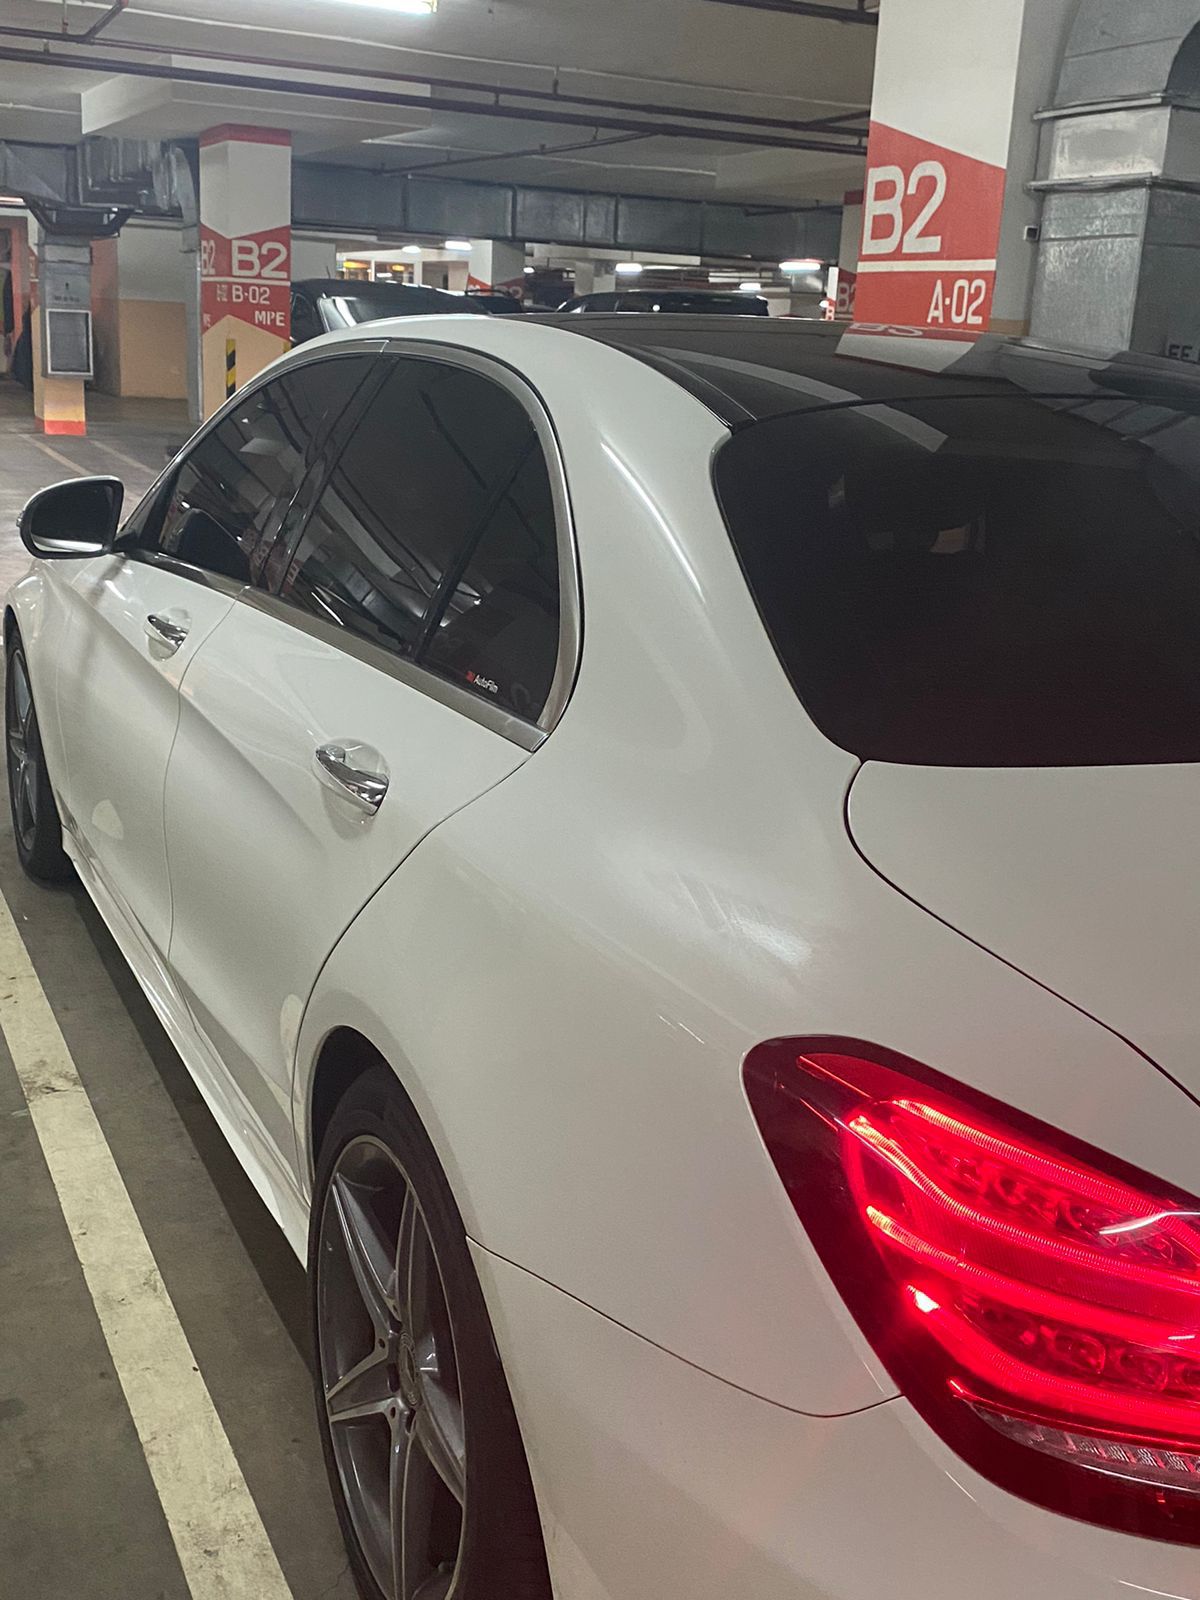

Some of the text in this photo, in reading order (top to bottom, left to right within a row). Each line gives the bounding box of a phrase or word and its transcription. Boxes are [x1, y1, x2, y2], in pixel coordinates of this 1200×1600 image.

[862, 160, 947, 255] B2
[231, 239, 288, 279] B2
[254, 310, 286, 327] MPE
